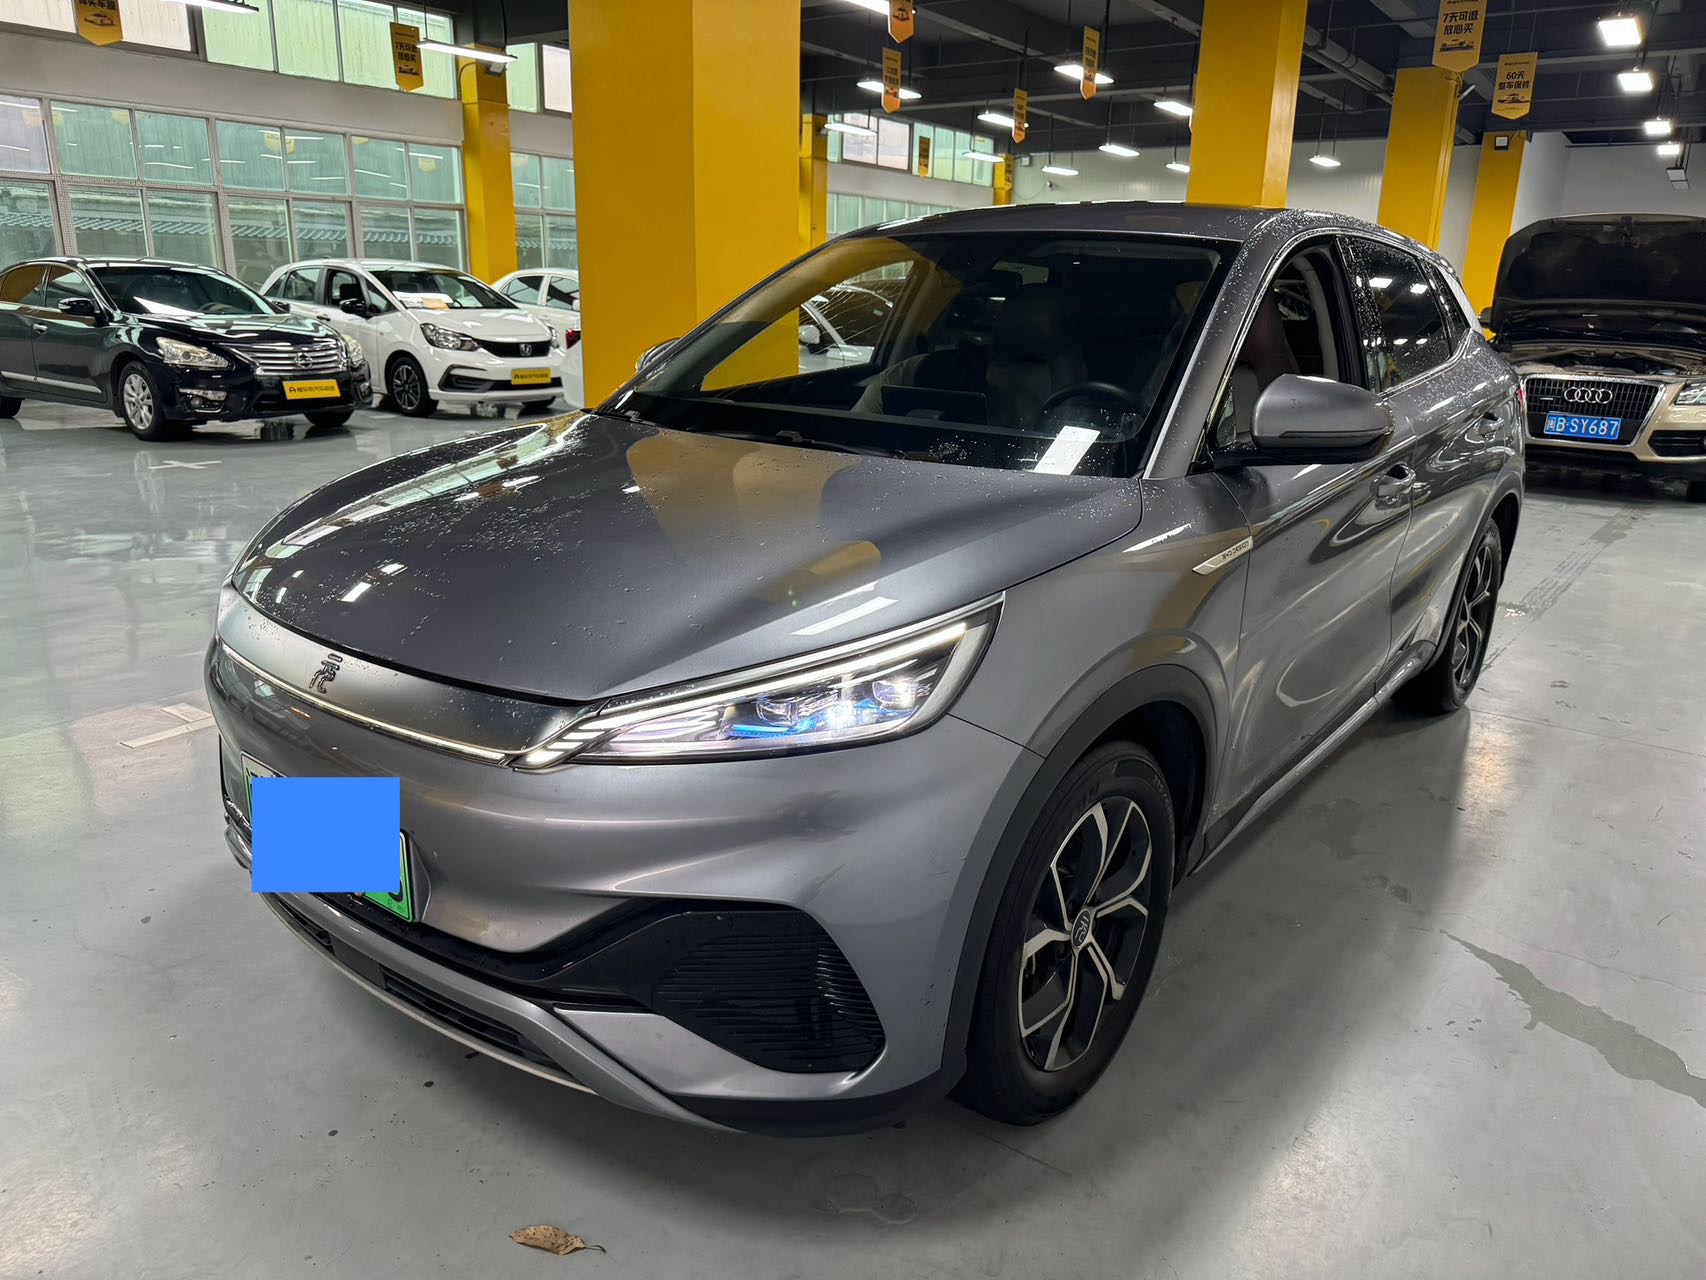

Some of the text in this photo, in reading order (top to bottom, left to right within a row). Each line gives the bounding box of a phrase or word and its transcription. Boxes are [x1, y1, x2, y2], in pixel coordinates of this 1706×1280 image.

[1443, 10, 1478, 23] 7天可退
[1444, 23, 1474, 36] 放心买
[1506, 70, 1525, 80] 60天
[1498, 80, 1531, 91] 整车保修
